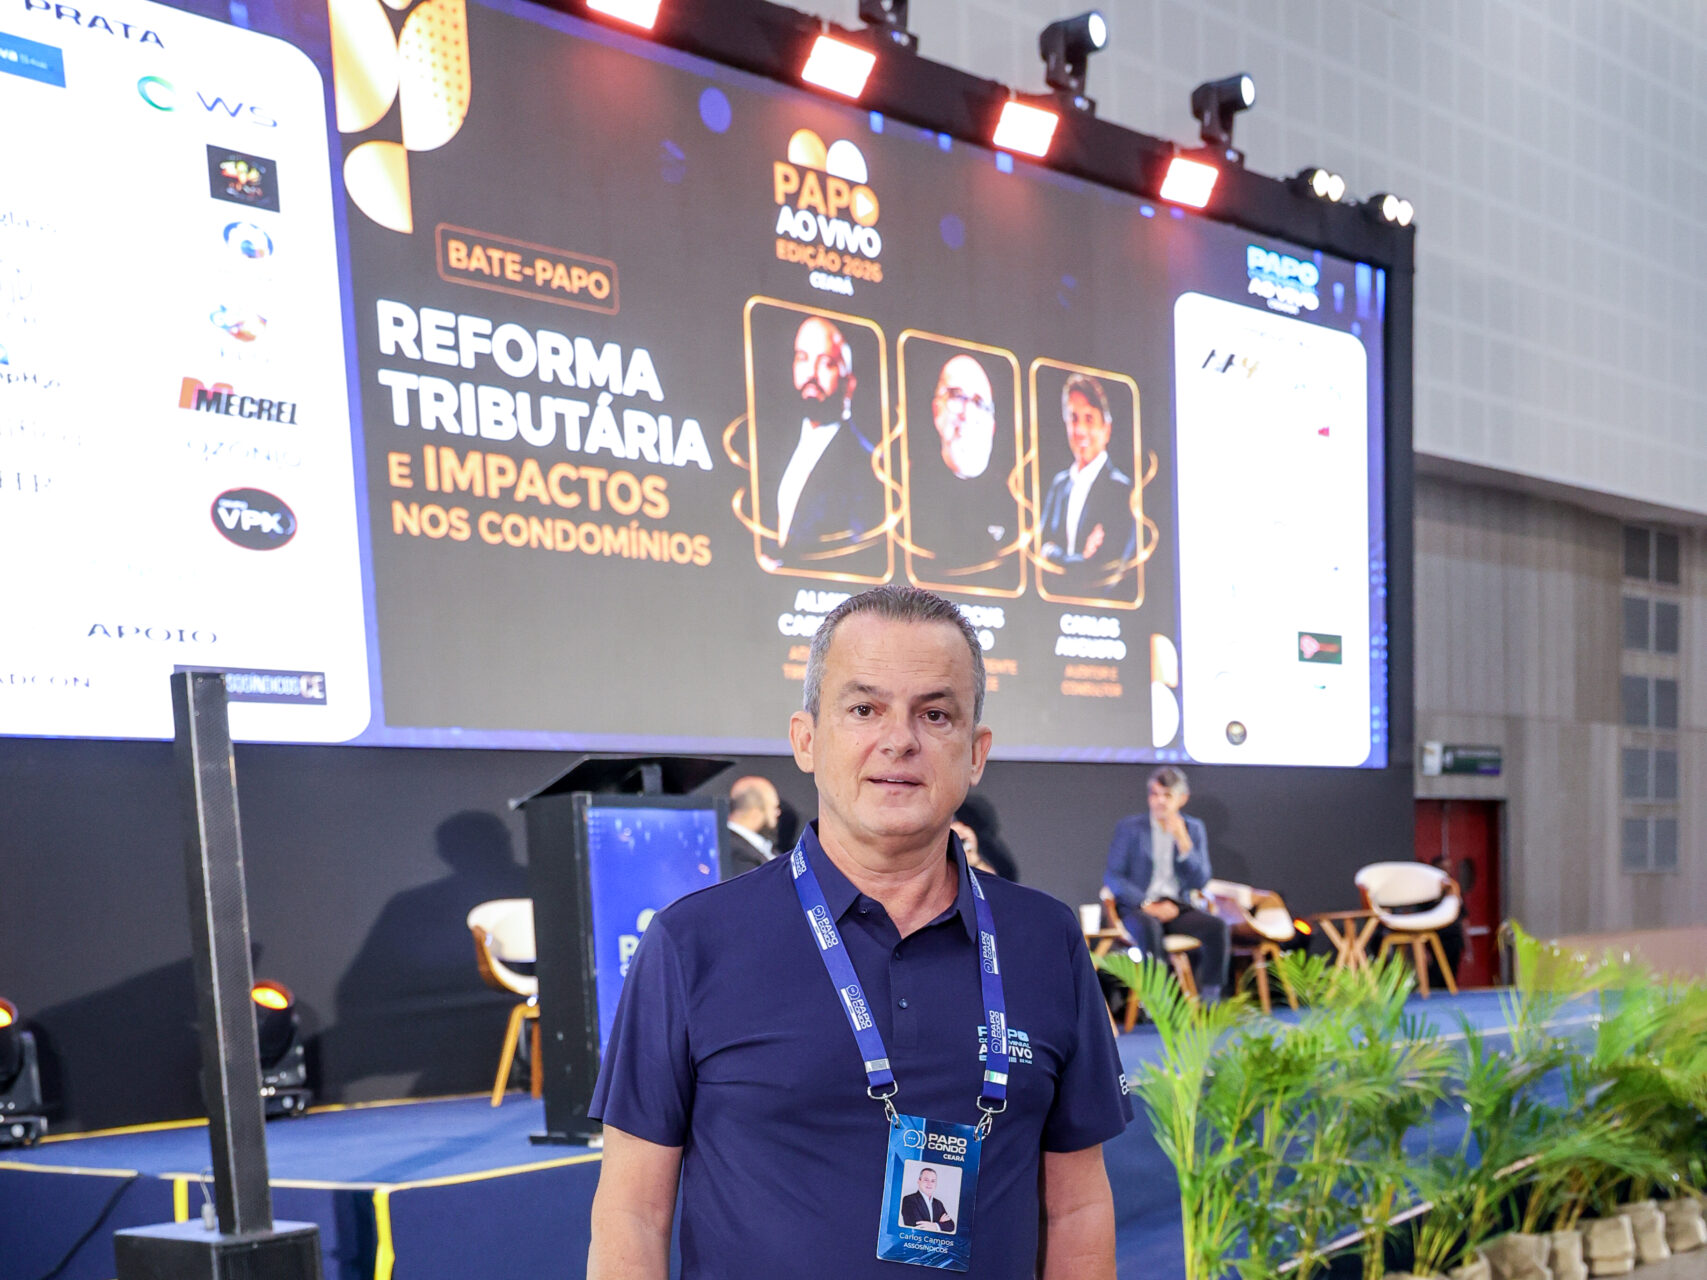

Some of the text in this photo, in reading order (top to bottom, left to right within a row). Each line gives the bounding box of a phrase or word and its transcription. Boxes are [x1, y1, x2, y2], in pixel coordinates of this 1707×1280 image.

[25, 0, 165, 49] PRATA
[773, 160, 879, 227] PAPO
[775, 205, 882, 258] AO VIVO
[447, 238, 611, 300] BATE-PAPO
[376, 299, 665, 401] REFORMA
[377, 368, 713, 470] TRIBUTÁRIA
[387, 444, 671, 519] E IMPACTOS
[391, 499, 713, 567] NOS CONDOMÍNIOS
[88, 623, 218, 643] APOIO
[818, 920, 834, 948] CONDO
[823, 919, 839, 946] PAPO
[981, 930, 989, 958] PAPO
[852, 1000, 867, 1030] CONDO
[857, 999, 873, 1028] PAPO
[989, 1010, 997, 1038] PAPO
[994, 1011, 1002, 1038] CONDO
[977, 1025, 1030, 1042] PPO
[927, 1142, 967, 1155] CONDO
[928, 1133, 968, 1147] PAPO
[942, 1153, 965, 1162] CEARÁ
[899, 1232, 954, 1247] Carlos Campos
